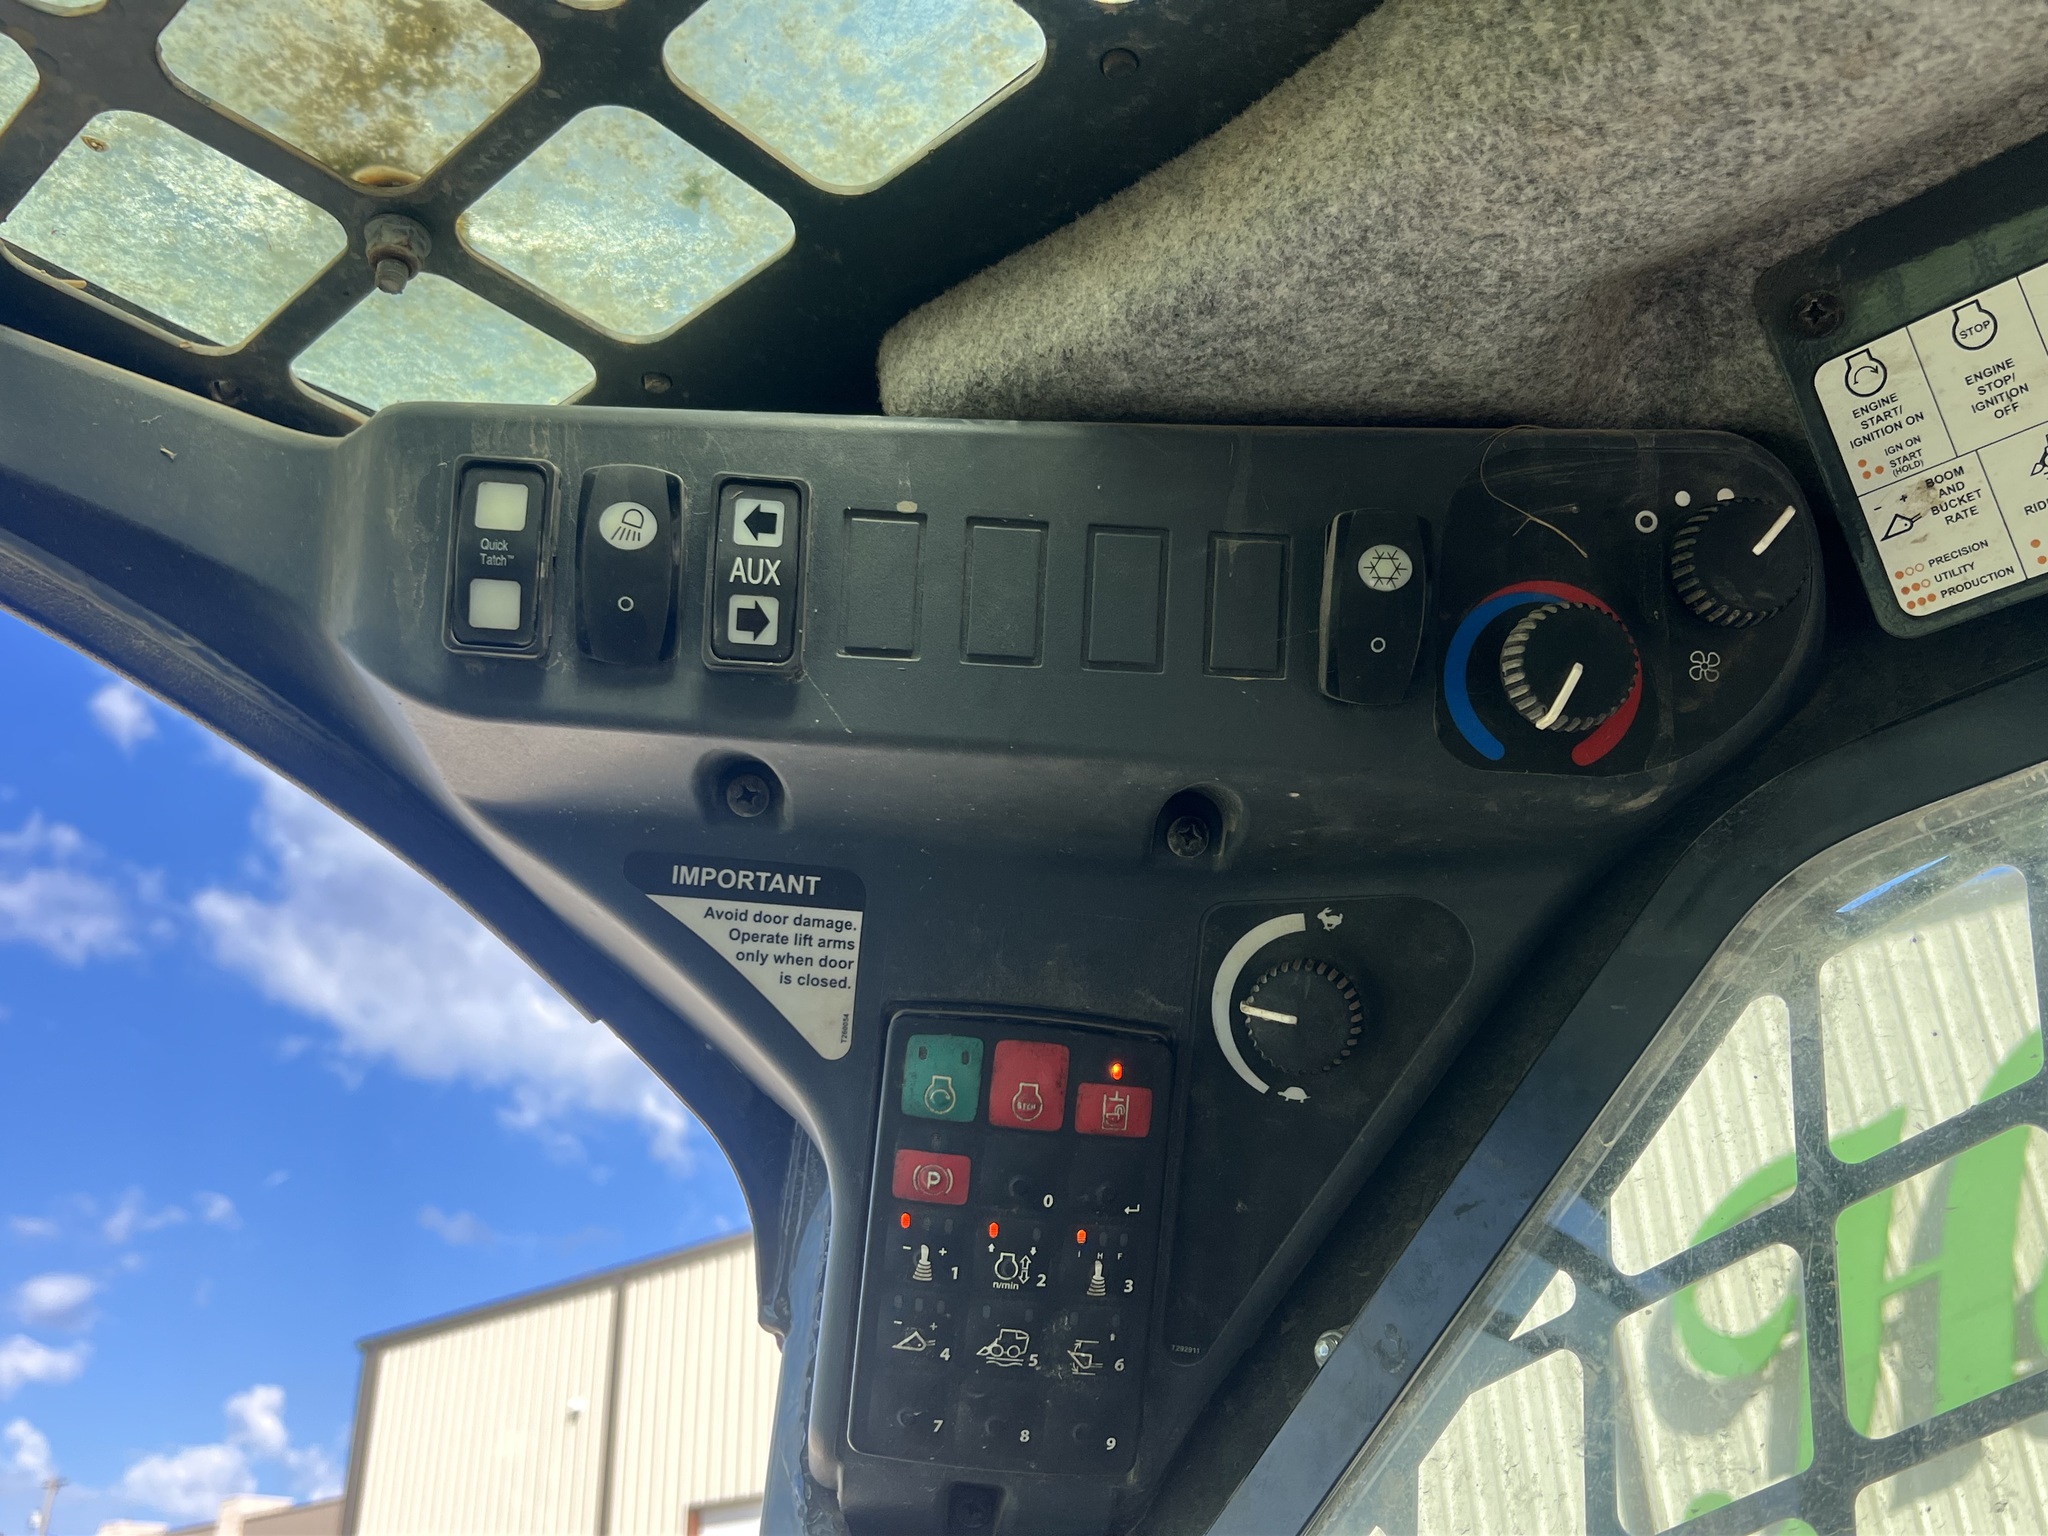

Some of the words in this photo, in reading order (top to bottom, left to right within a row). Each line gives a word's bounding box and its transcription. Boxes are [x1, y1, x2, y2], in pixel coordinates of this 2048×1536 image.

[1959, 320, 1990, 339] STOP
[1965, 358, 2015, 385] ENGINE
[1977, 372, 2015, 395] STOP/
[1852, 393, 1899, 418] ENGINE
[1971, 383, 2029, 413] IGNITION
[1861, 405, 1902, 429] START/
[1994, 402, 2019, 419] OFF
[1850, 421, 1903, 449] IGNITION
[1905, 411, 1924, 425] ON
[1884, 443, 1903, 456] IGN
[1905, 435, 1921, 447] ON
[1890, 449, 1922, 468] START
[1893, 460, 1924, 477] (HOLD)
[1925, 466, 1965, 488] BOOM
[1939, 481, 1965, 498] AND
[1931, 489, 1981, 516] BUCKET
[2024, 498, 2048, 515] RID
[1945, 505, 1979, 525] RATE
[480, 537, 509, 551] Quick
[1928, 540, 1989, 567] PRECISION
[729, 556, 782, 585] AUX
[1934, 561, 1975, 583] UTILITY
[1940, 566, 2015, 598] PRODUCTION
[671, 865, 821, 895] IMPORTANT
[703, 907, 748, 922] Avoid
[753, 911, 789, 925] door
[793, 914, 857, 933] damage.
[729, 928, 789, 944] Operate
[794, 932, 813, 947] lift
[818, 938, 855, 950] arms
[736, 950, 769, 966] only
[773, 952, 813, 967] when
[818, 956, 854, 970] door
[779, 972, 792, 985] is
[797, 974, 851, 989] closed.
[926, 1171, 941, 1189] P
[1043, 1194, 1054, 1208] 0
[1117, 1252, 1123, 1260] F
[951, 1267, 959, 1280] 1
[1037, 1274, 1047, 1287] 2
[993, 1281, 1019, 1291] n/min
[1124, 1280, 1134, 1293] 3
[940, 1348, 950, 1361] 4
[1028, 1353, 1039, 1367] 5
[1114, 1358, 1125, 1371] 6
[933, 1420, 943, 1433] 7
[1019, 1430, 1030, 1443] 8
[1106, 1438, 1116, 1450] 9
